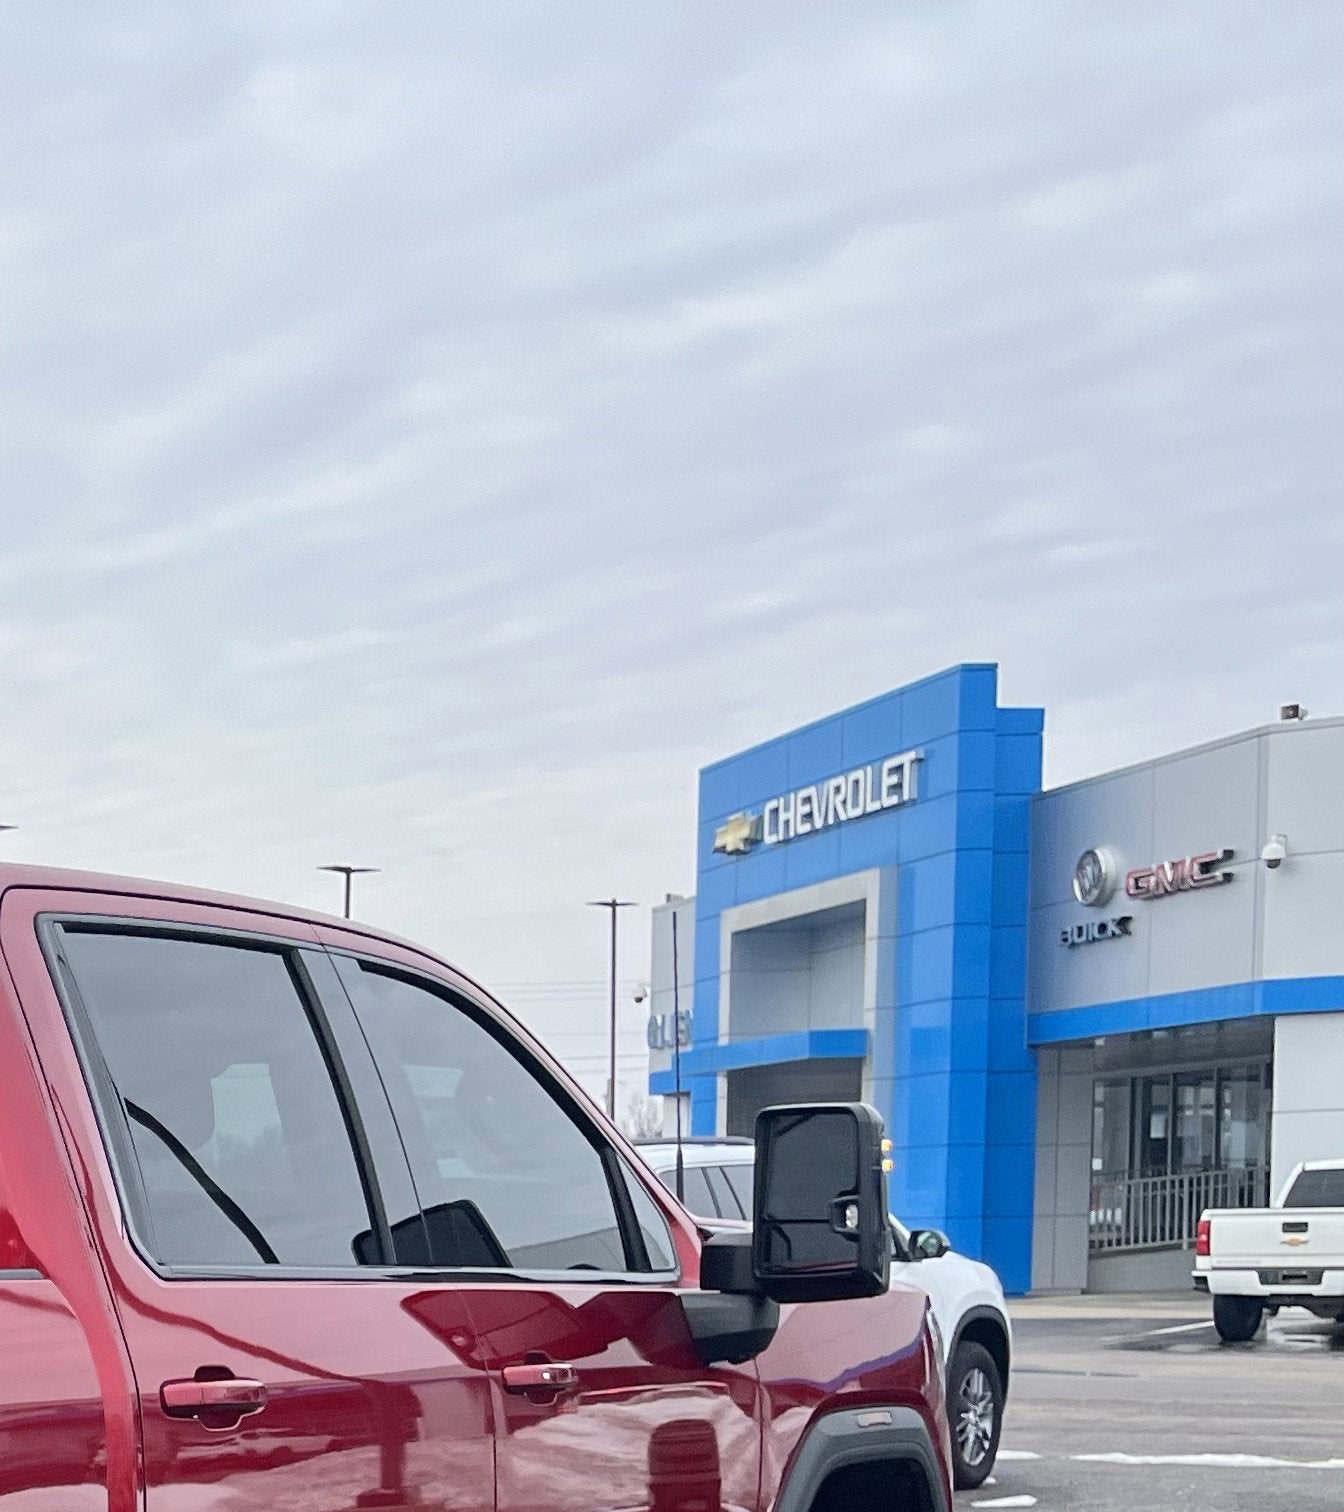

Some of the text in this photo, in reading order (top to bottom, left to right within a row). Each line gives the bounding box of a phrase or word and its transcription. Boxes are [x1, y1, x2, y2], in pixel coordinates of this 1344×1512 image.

[764, 750, 924, 845] CHEVROLET
[1125, 850, 1234, 898] GMC
[1061, 916, 1132, 947] BUICK
